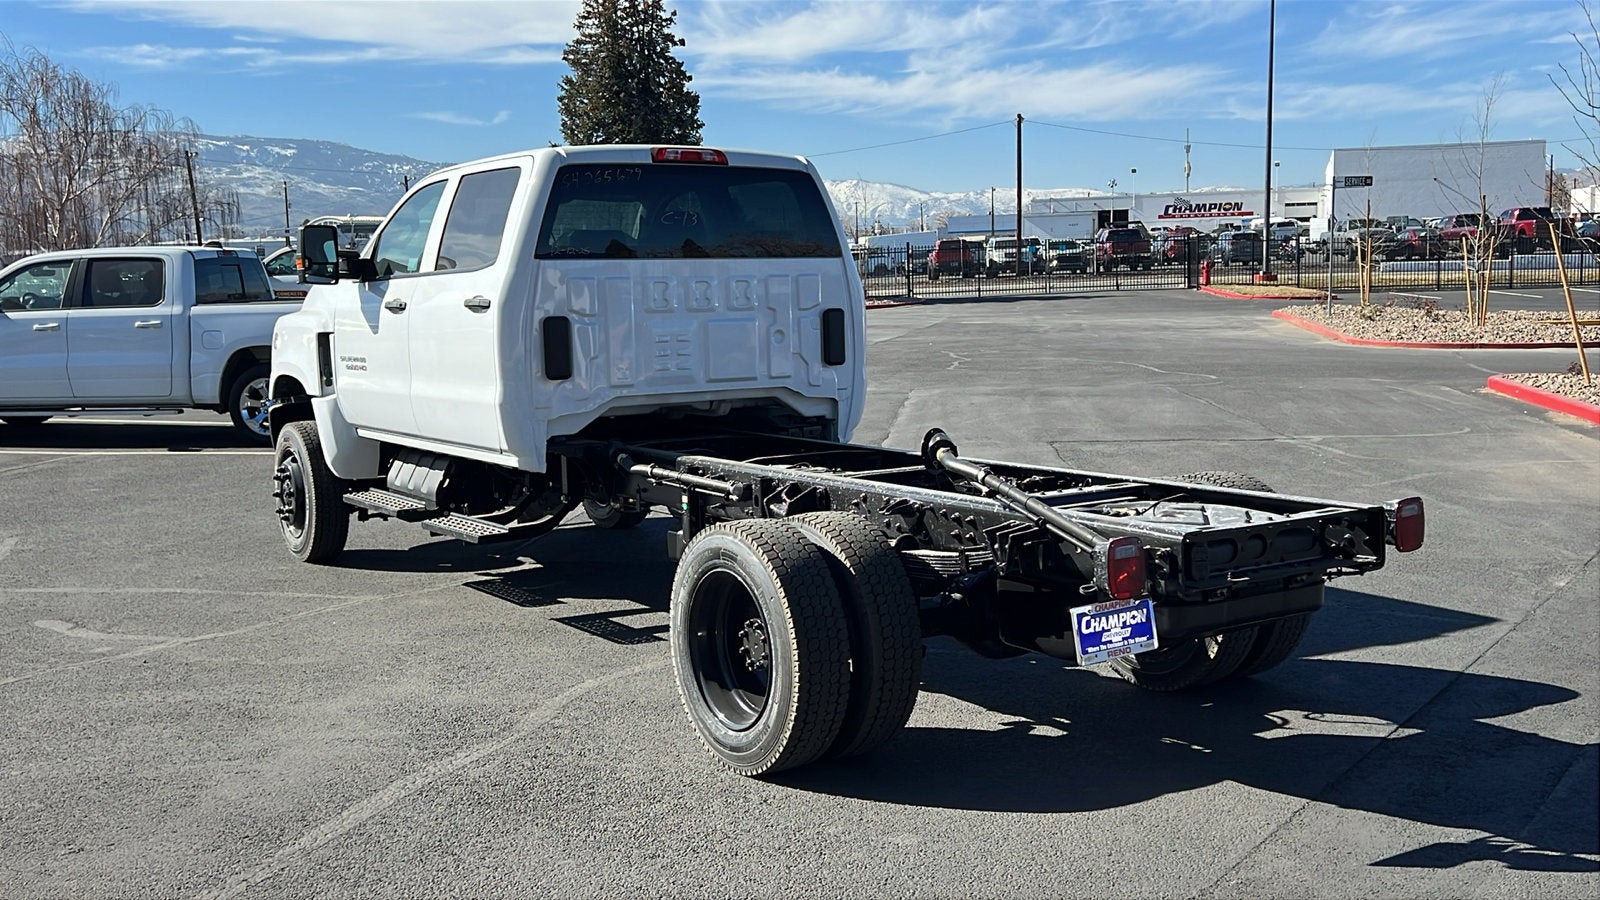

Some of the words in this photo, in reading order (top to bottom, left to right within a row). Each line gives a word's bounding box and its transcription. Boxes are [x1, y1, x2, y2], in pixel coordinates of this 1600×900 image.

[1345, 177, 1366, 186] SERVICE
[1164, 201, 1243, 216] CHAMPION
[661, 211, 698, 226] C-13
[1094, 599, 1132, 612] CHAMPION
[1081, 608, 1147, 634] CHAMPION
[1103, 629, 1129, 640] CHEVROLET
[1107, 647, 1132, 658] RENO
